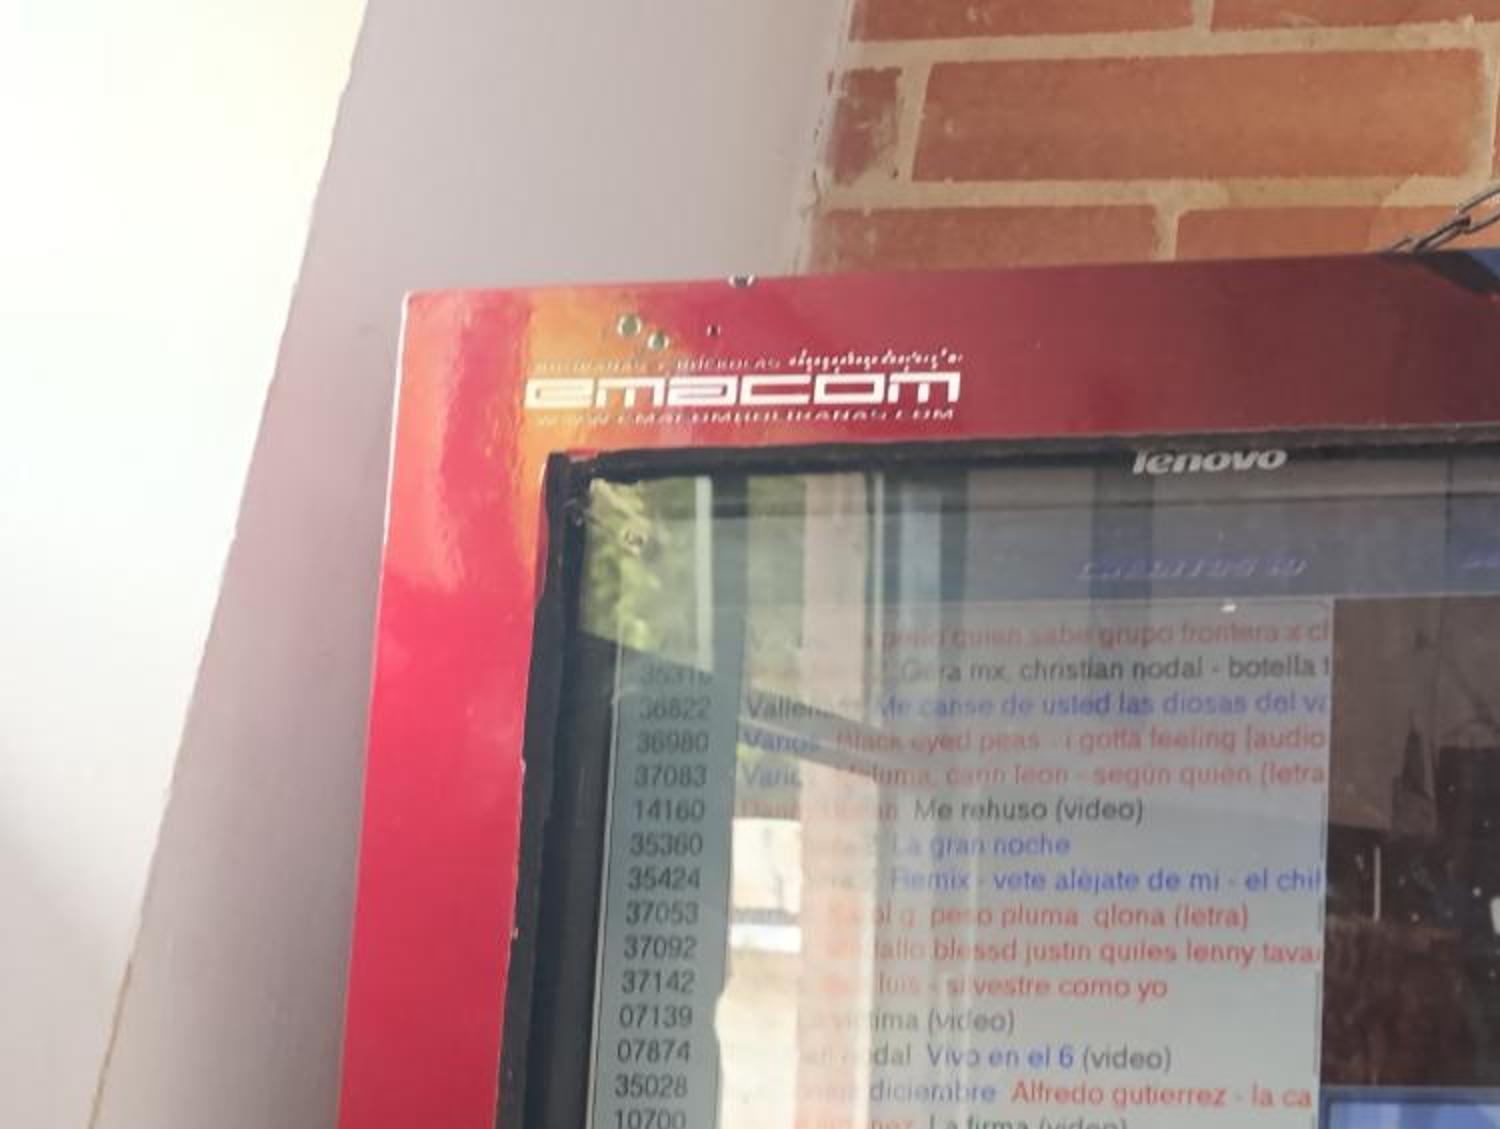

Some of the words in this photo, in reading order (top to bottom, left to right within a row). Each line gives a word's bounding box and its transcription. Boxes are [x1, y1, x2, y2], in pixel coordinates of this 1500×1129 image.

[1133, 447, 1289, 477] lenovo
[1020, 657, 1123, 682] christian
[1131, 657, 1203, 680] nodal
[1227, 656, 1318, 679] botella
[1042, 693, 1112, 717] usted
[1119, 692, 1154, 716] las
[1161, 692, 1248, 717] diosas
[1255, 691, 1296, 715] del
[1150, 726, 1238, 754] feeling
[634, 764, 708, 788] 37083
[633, 799, 706, 823] 14160
[1055, 797, 1146, 828] (video)
[629, 832, 705, 856] 35360
[992, 833, 1072, 857] noche
[626, 867, 703, 892] 35424
[992, 869, 1047, 892] vete
[1146, 867, 1181, 892] de
[1245, 867, 1269, 892] el
[624, 902, 700, 926] 37053
[1175, 903, 1249, 930] (letra)
[622, 936, 700, 961] 37092
[1024, 938, 1091, 966] justin
[1099, 938, 1178, 967] quiles
[1186, 938, 1256, 967] lenny
[620, 971, 697, 995] 37142
[1057, 975, 1131, 1000] como
[1137, 976, 1170, 1006] yo
[618, 1004, 694, 1031] 07139
[615, 1039, 693, 1065] 07874
[988, 1050, 1021, 1069] en
[1026, 1046, 1050, 1069] el
[1057, 1044, 1075, 1069] 6
[1082, 1045, 1172, 1075] (video)
[613, 1073, 690, 1099] 35028
[1009, 1079, 1105, 1106] Alfredo
[1251, 1080, 1275, 1107] la
